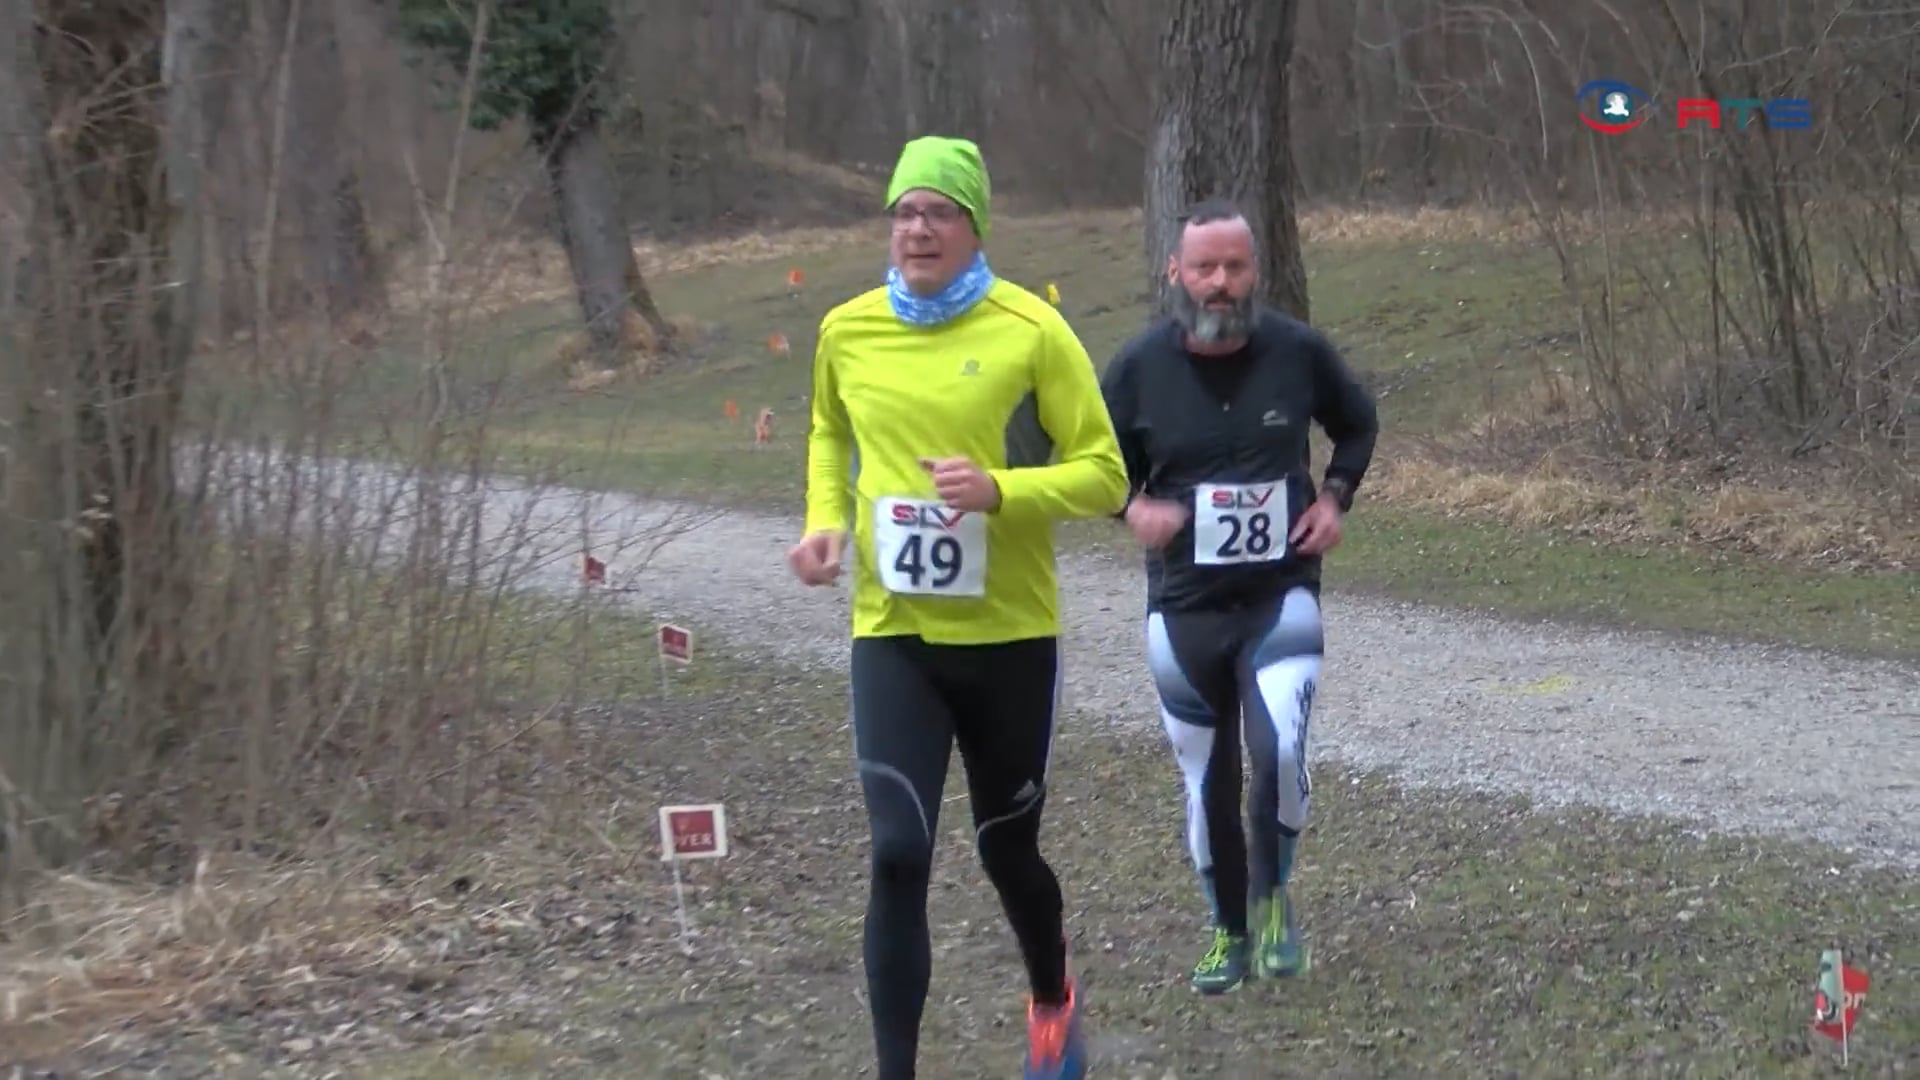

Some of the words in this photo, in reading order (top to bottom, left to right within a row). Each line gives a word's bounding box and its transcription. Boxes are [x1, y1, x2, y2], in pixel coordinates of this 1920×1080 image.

[1212, 487, 1274, 509] SLV
[892, 504, 966, 530] SLV
[1216, 512, 1271, 557] 28
[895, 534, 964, 588] 49
